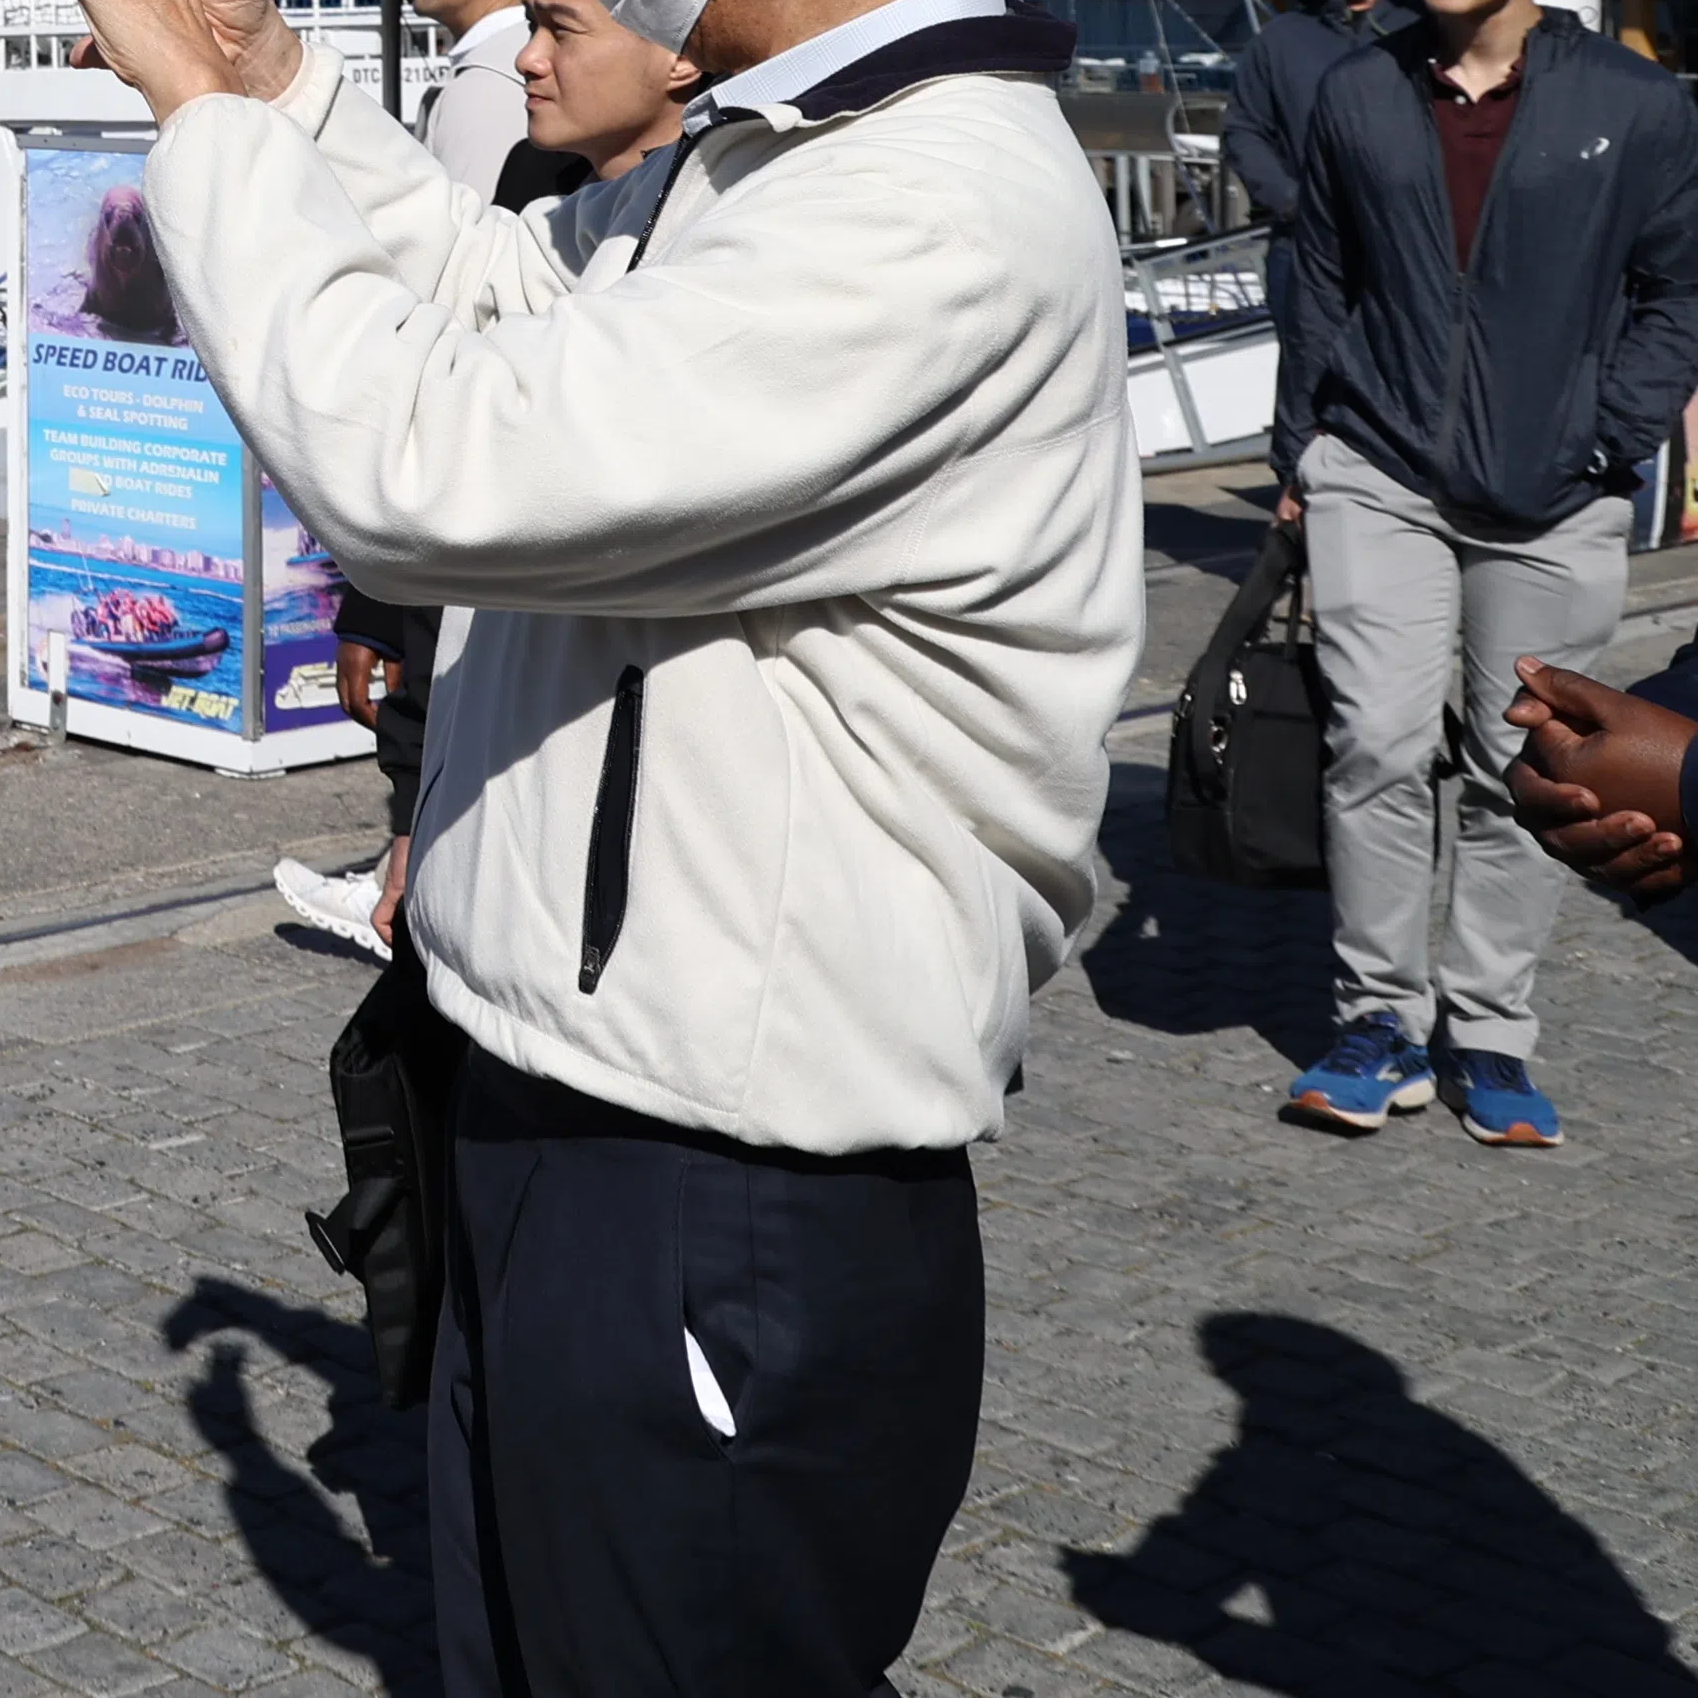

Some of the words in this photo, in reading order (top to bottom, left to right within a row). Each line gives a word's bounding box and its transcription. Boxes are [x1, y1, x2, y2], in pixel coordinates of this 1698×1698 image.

[32, 343, 99, 369] SPEED
[102, 350, 169, 379] BOAT
[171, 358, 210, 383] RID
[63, 385, 90, 400] ECO
[91, 387, 135, 406] TOURS
[142, 393, 204, 414] DOLPHIN
[77, 405, 87, 418] &
[89, 406, 121, 422] SEAL
[123, 409, 188, 431] SPOTTING
[43, 429, 79, 444] TEAM
[80, 433, 142, 454] BUILDING
[143, 442, 228, 466] CORPORATE
[50, 448, 101, 467] GROUPS
[103, 454, 138, 472] WITH
[139, 461, 220, 484] ADRENALIN
[115, 474, 152, 493] BOAT
[154, 481, 193, 499] RIDES
[71, 498, 126, 519] PRIVATE
[127, 506, 197, 531] CHARTERS
